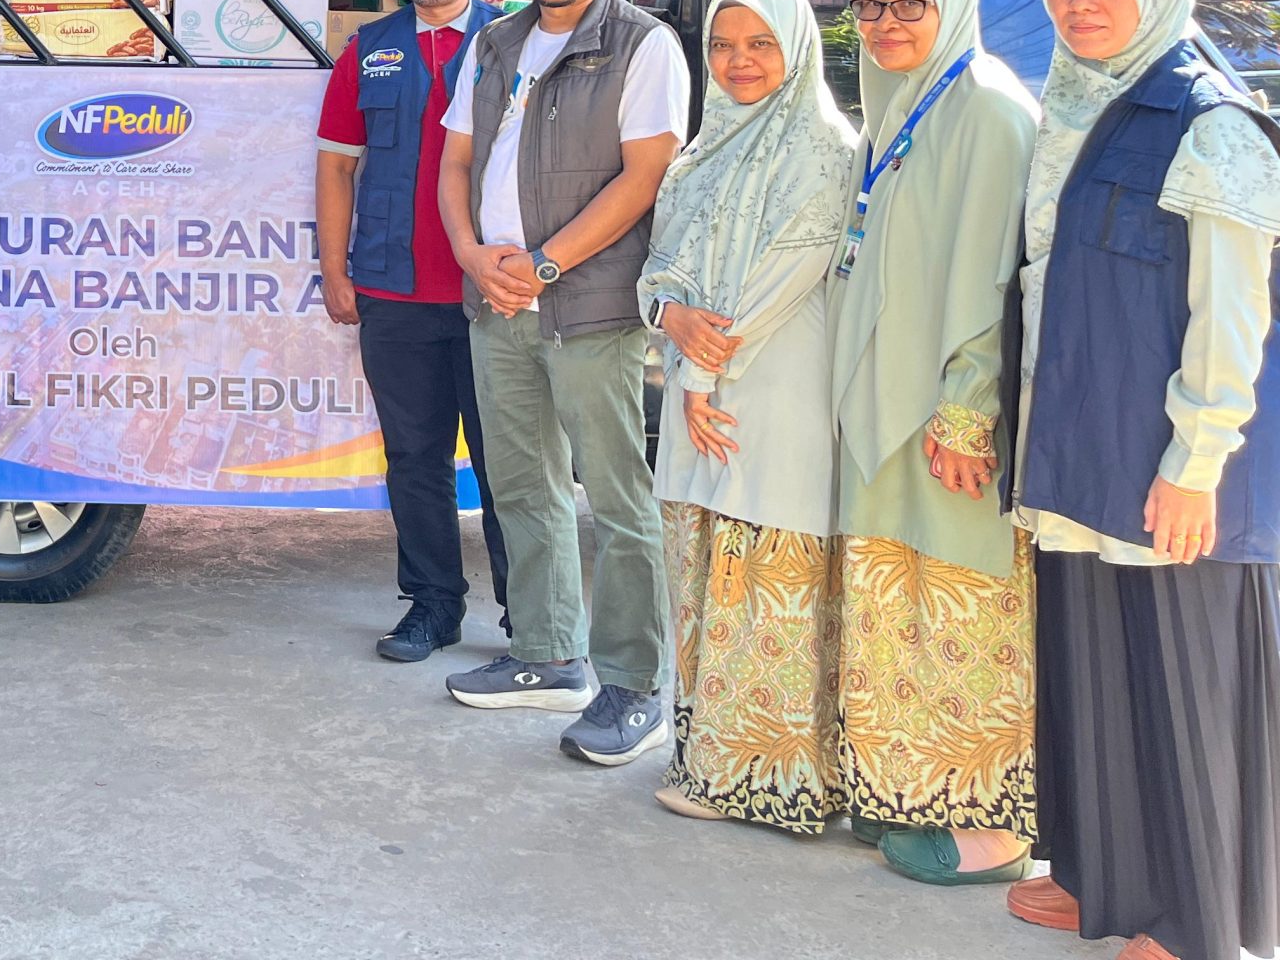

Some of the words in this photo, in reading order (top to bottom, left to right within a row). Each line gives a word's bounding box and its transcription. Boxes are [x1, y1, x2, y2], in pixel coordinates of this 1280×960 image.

[370, 70, 391, 78] ACEH
[58, 104, 189, 135] NFPeduli
[36, 161, 97, 173] Commitment
[102, 163, 111, 172] to
[115, 162, 137, 173] Care
[140, 163, 160, 173] and
[162, 163, 192, 174] Share
[72, 180, 155, 196] ACEH
[178, 219, 319, 259] BANT
[74, 270, 279, 313] BANJIR
[296, 274, 325, 312] A
[69, 326, 157, 358] Oleh
[47, 373, 168, 409] FIKRI
[187, 376, 364, 413] PEDULI
